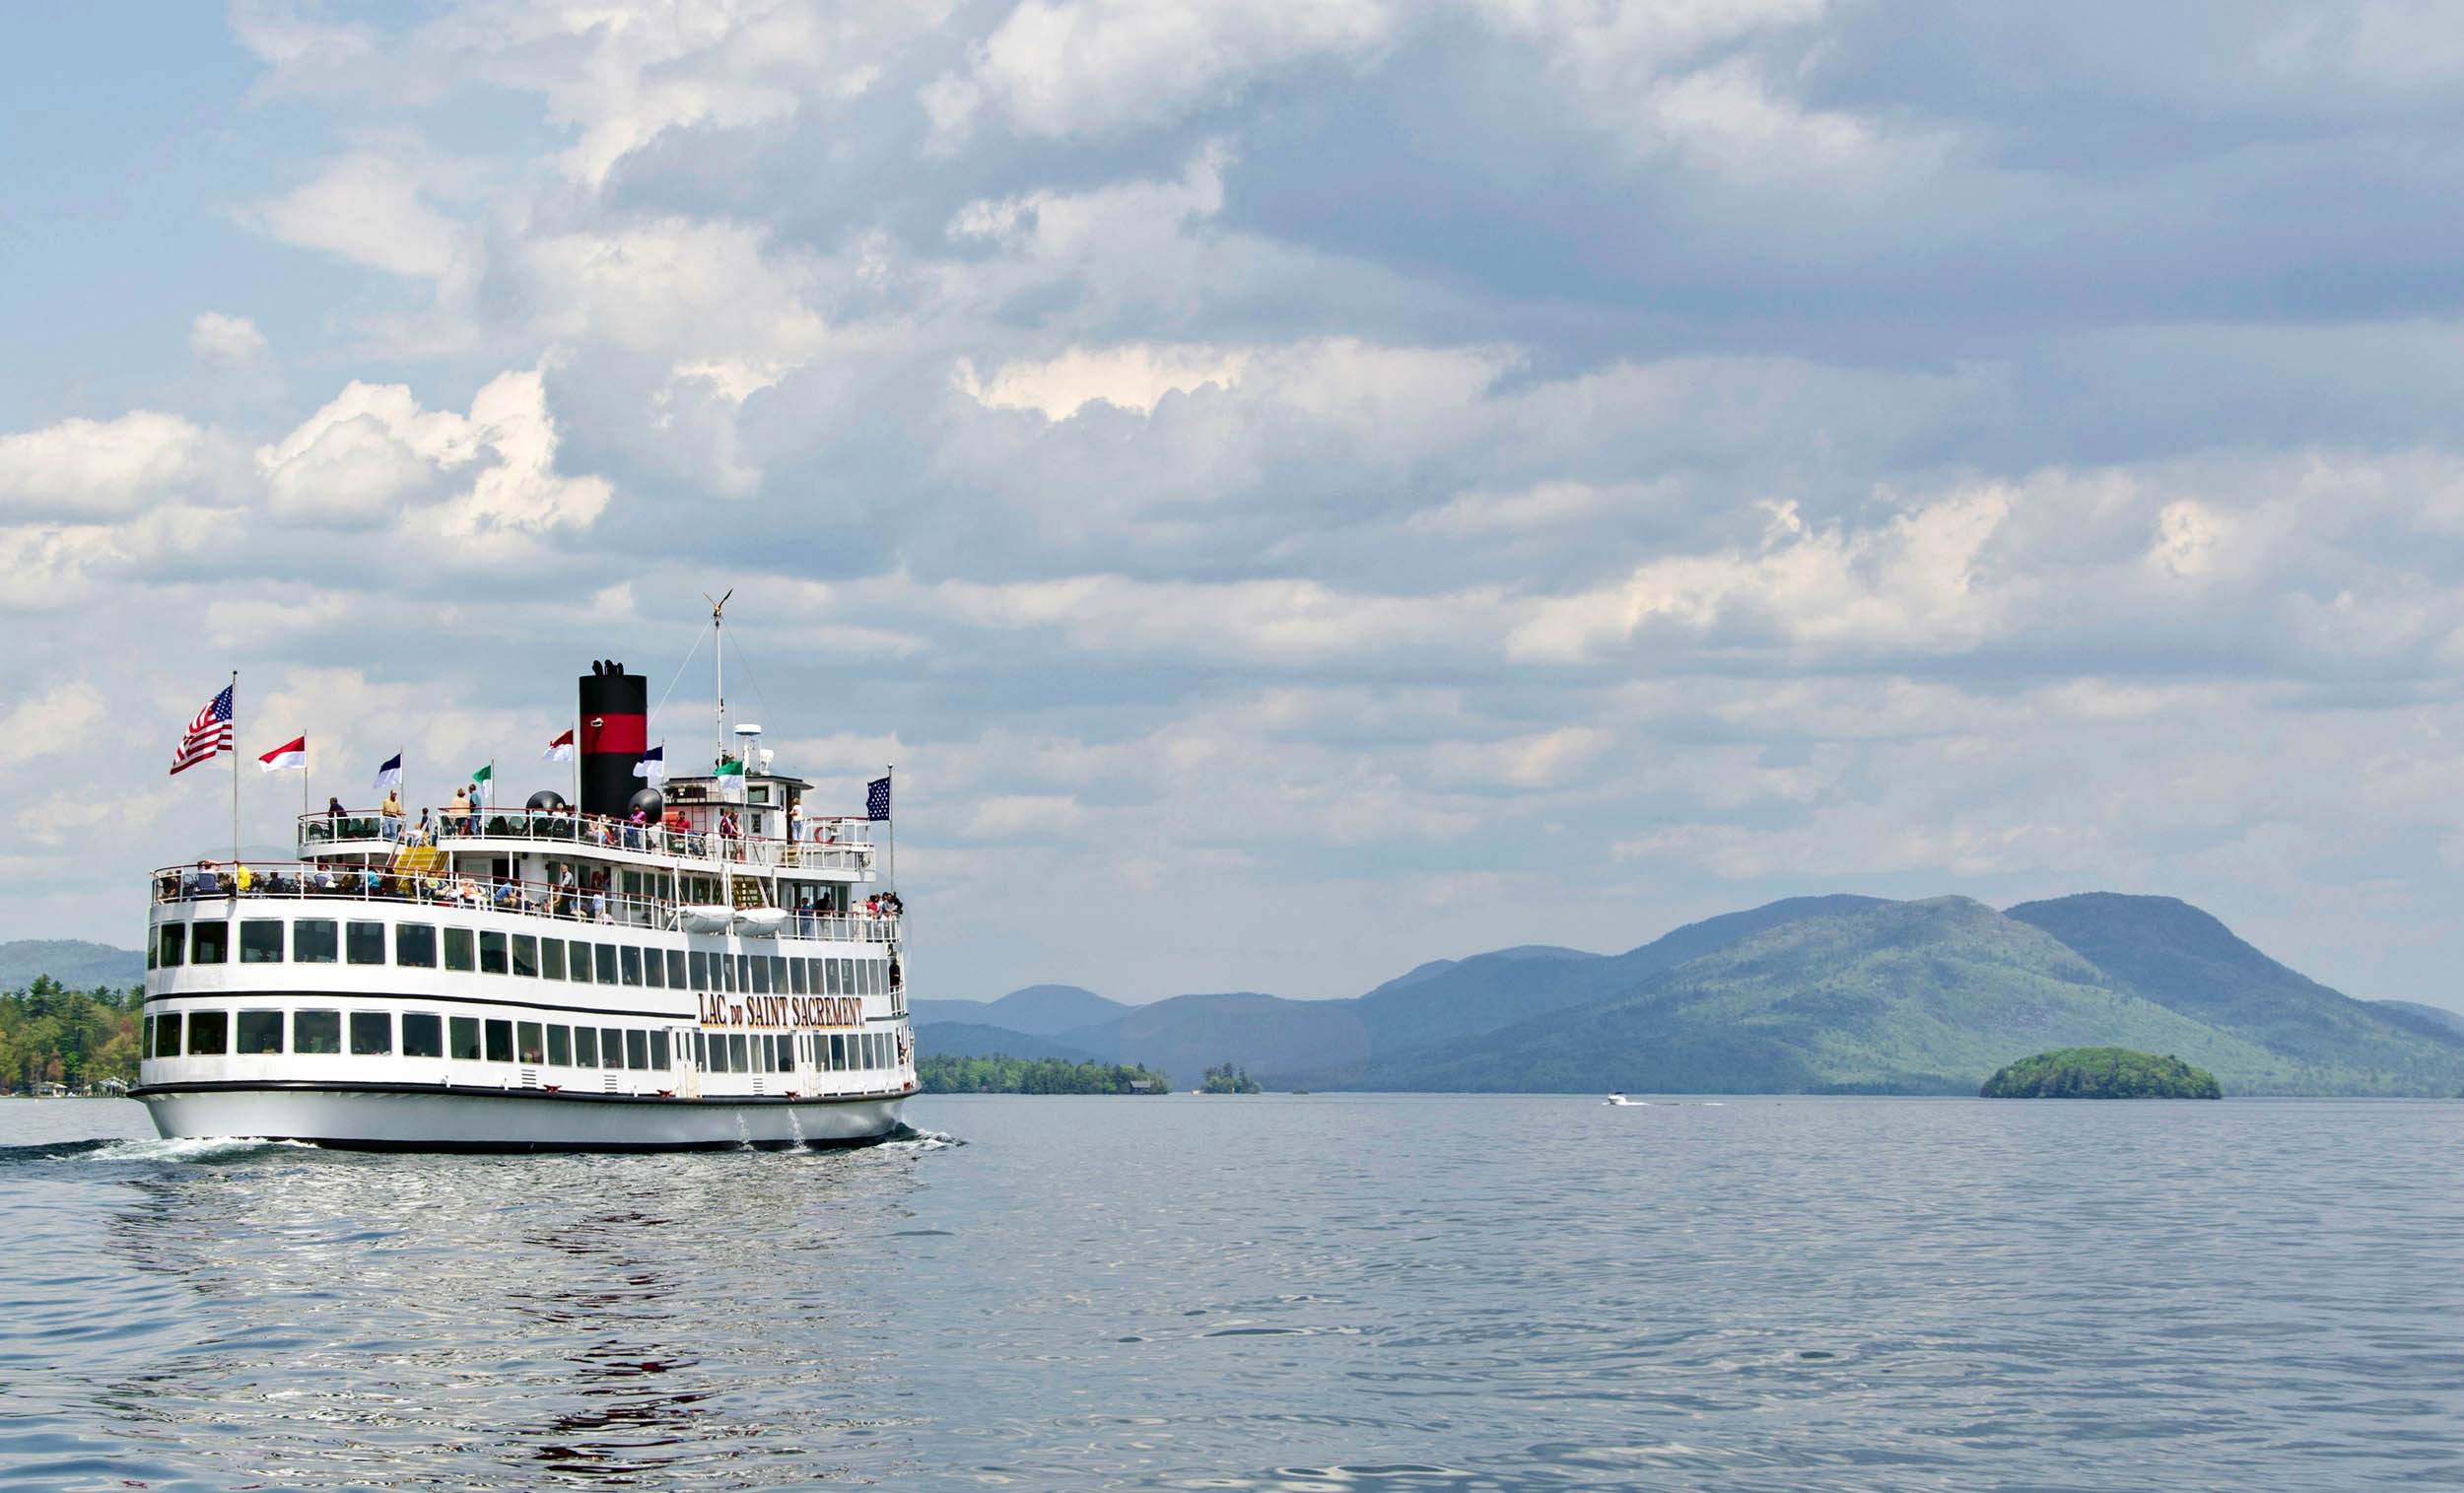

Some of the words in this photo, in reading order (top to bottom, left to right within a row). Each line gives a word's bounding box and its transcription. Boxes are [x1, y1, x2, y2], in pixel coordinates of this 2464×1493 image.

[698, 993, 726, 1028] LAC
[729, 1005, 743, 1029] DU
[746, 995, 788, 1030] SAINT
